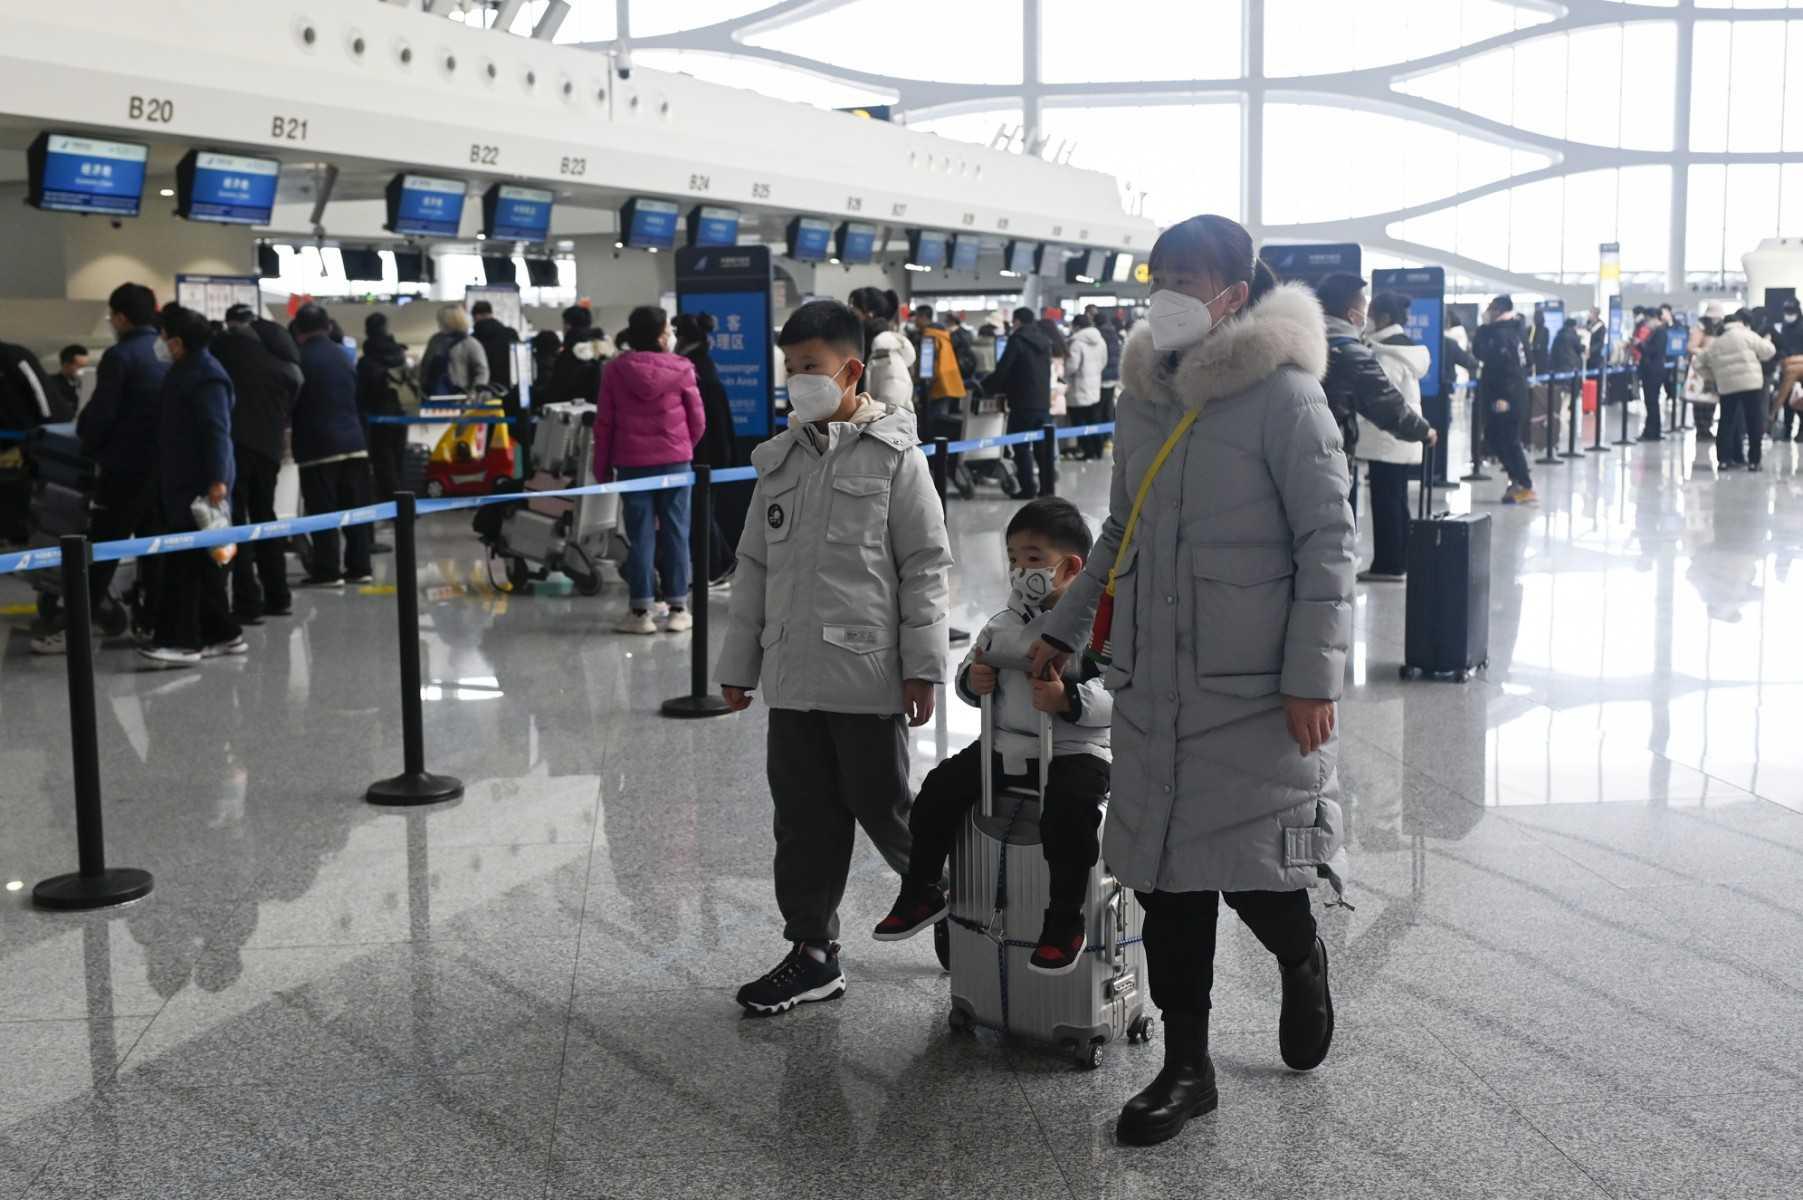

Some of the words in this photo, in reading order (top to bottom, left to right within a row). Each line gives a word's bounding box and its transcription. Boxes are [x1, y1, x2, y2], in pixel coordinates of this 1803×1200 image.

[129, 96, 174, 123] B20
[271, 116, 308, 140] B21
[470, 144, 499, 165] B22
[560, 156, 586, 176] B23
[689, 173, 710, 191] B24
[752, 182, 771, 198] B25
